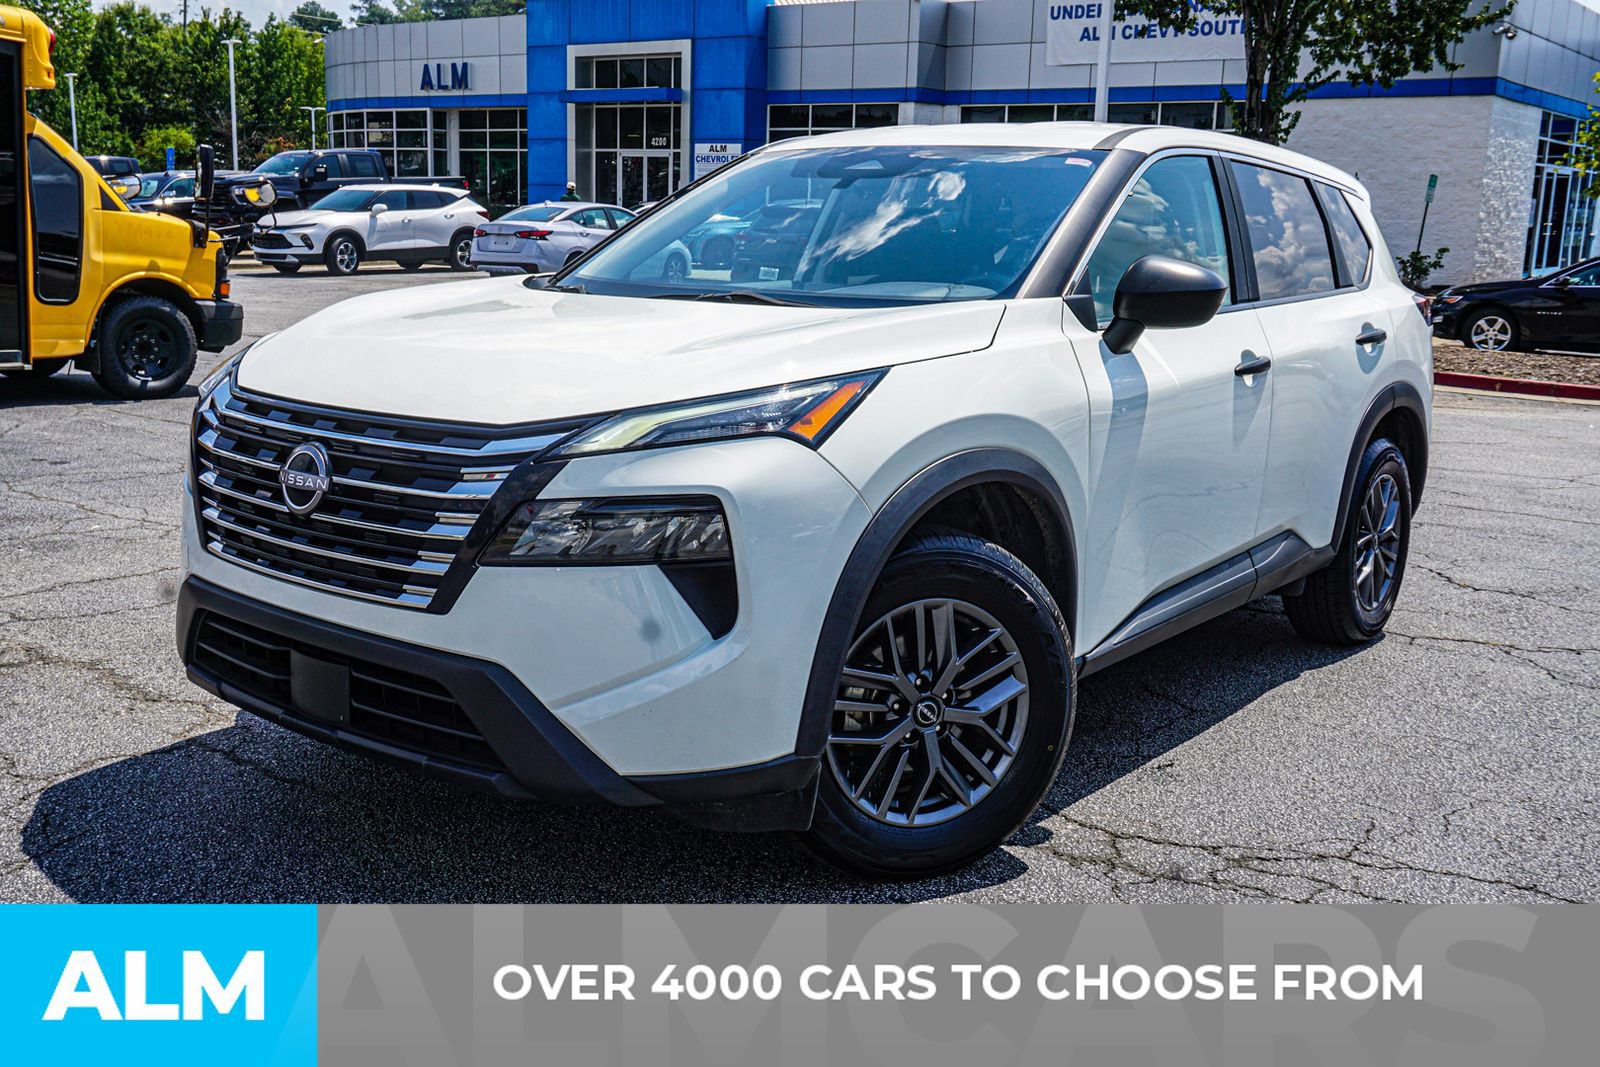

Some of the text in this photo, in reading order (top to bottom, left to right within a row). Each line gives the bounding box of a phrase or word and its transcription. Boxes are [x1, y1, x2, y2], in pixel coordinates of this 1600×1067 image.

[1079, 25, 1116, 42] AL
[420, 62, 470, 91] ALM
[650, 136, 667, 146] 4200
[709, 144, 727, 153] ALM
[280, 470, 328, 490] NISSAN
